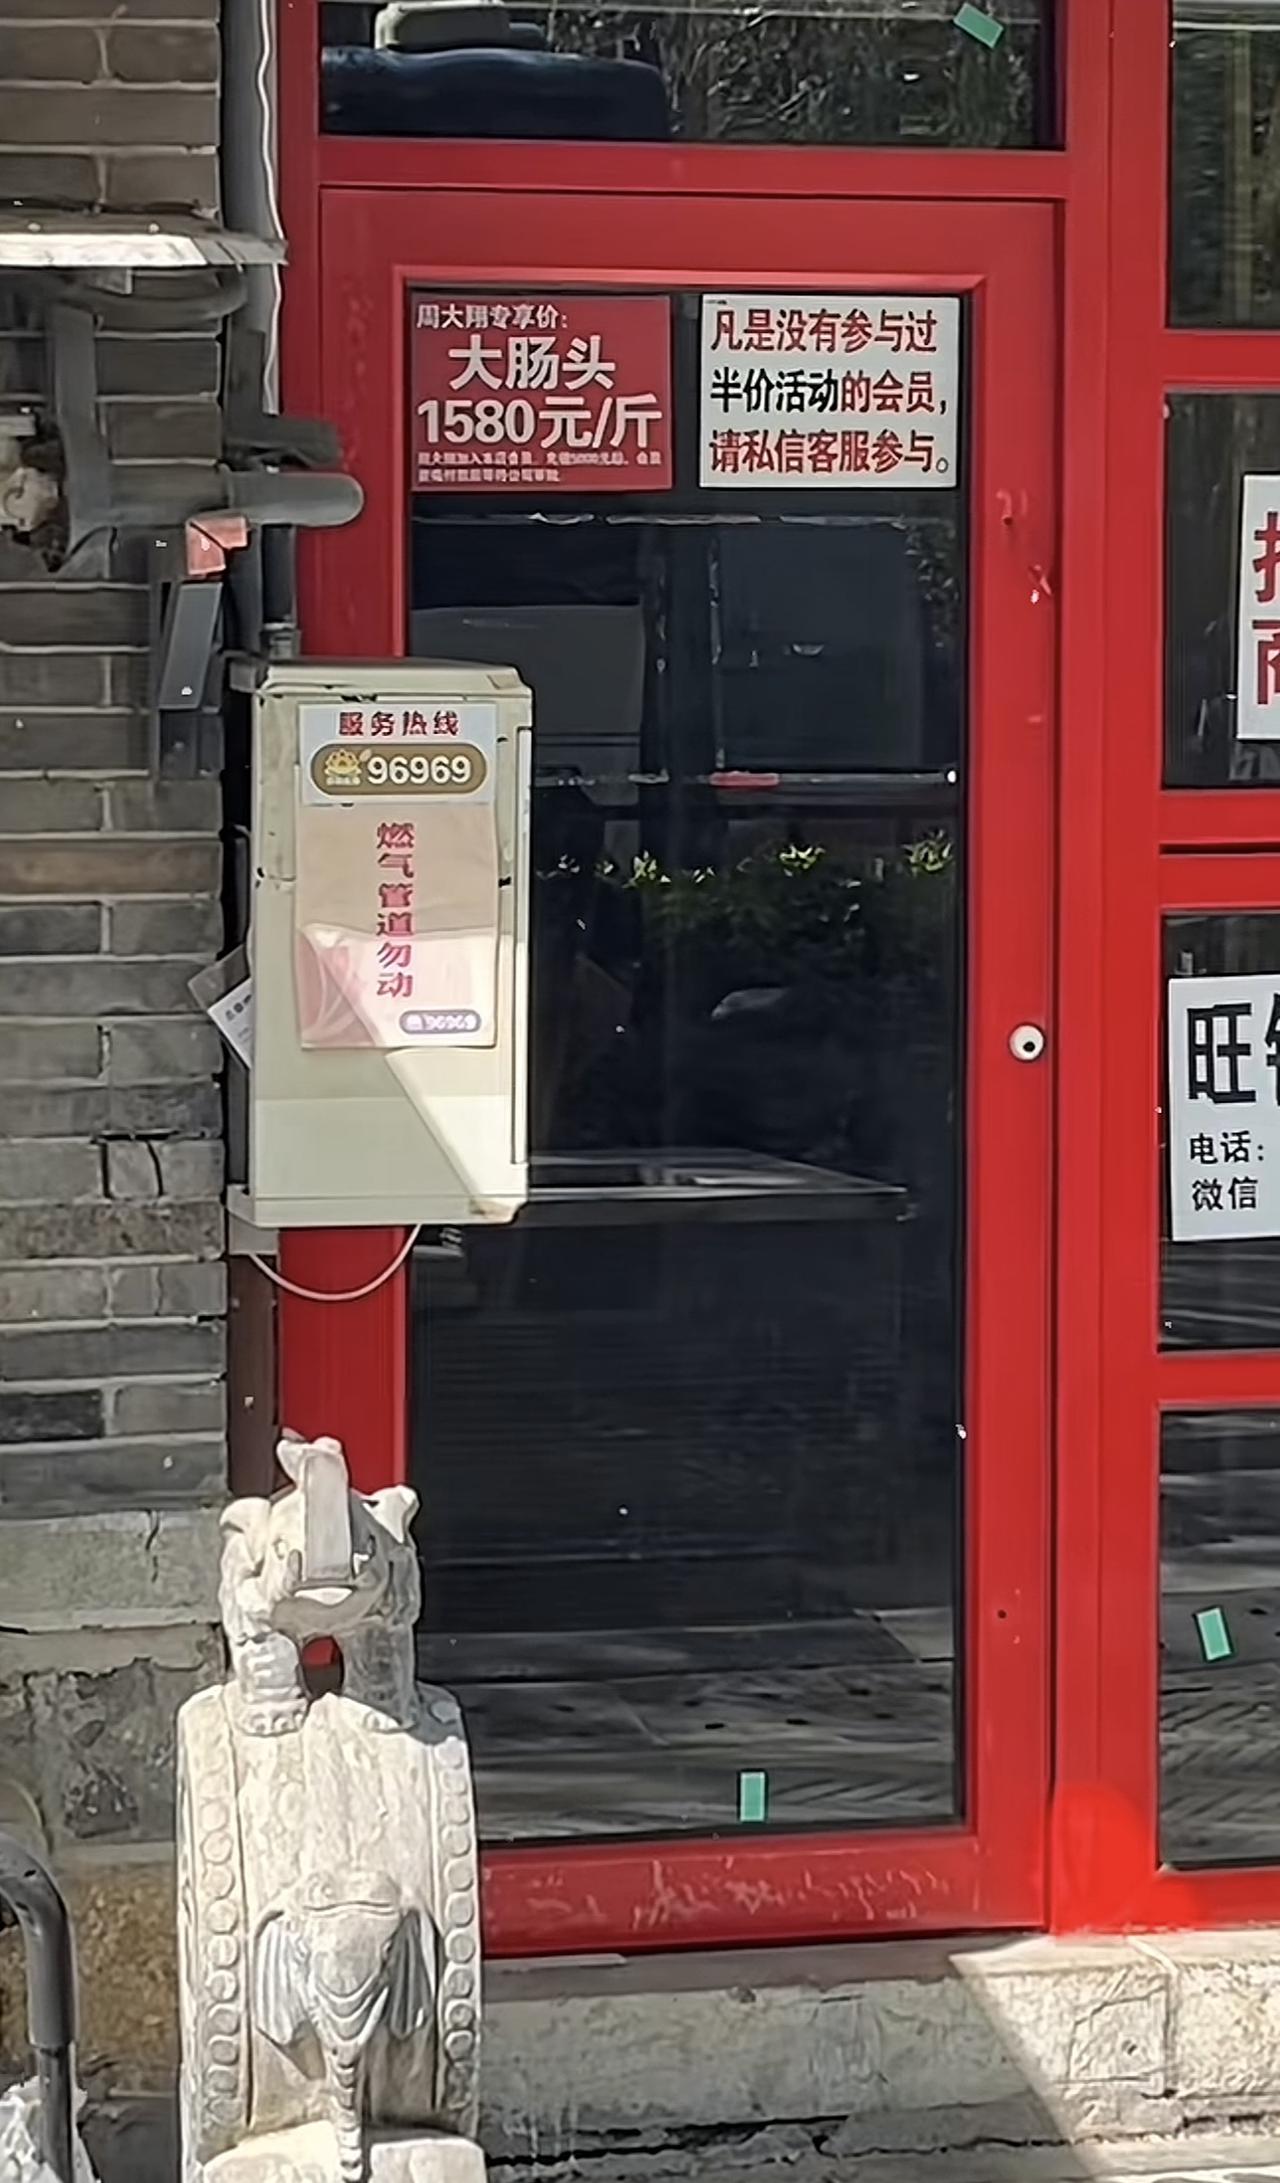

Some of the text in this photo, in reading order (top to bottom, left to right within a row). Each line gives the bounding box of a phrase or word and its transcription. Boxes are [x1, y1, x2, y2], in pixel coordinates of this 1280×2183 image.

[710, 308, 938, 353] 凡是没有参与过
[448, 333, 616, 390] 大肠头
[710, 366, 947, 414] 半价活动的会员,
[417, 393, 662, 448] 1580元/斤
[708, 429, 949, 473] 请私信客服参与。
[338, 710, 459, 737] 服务热线
[366, 755, 472, 785] 96969
[376, 822, 415, 998] 燃气管道勿动
[1190, 1130, 1264, 1164] 电话:
[1191, 1176, 1258, 1211] 微信
